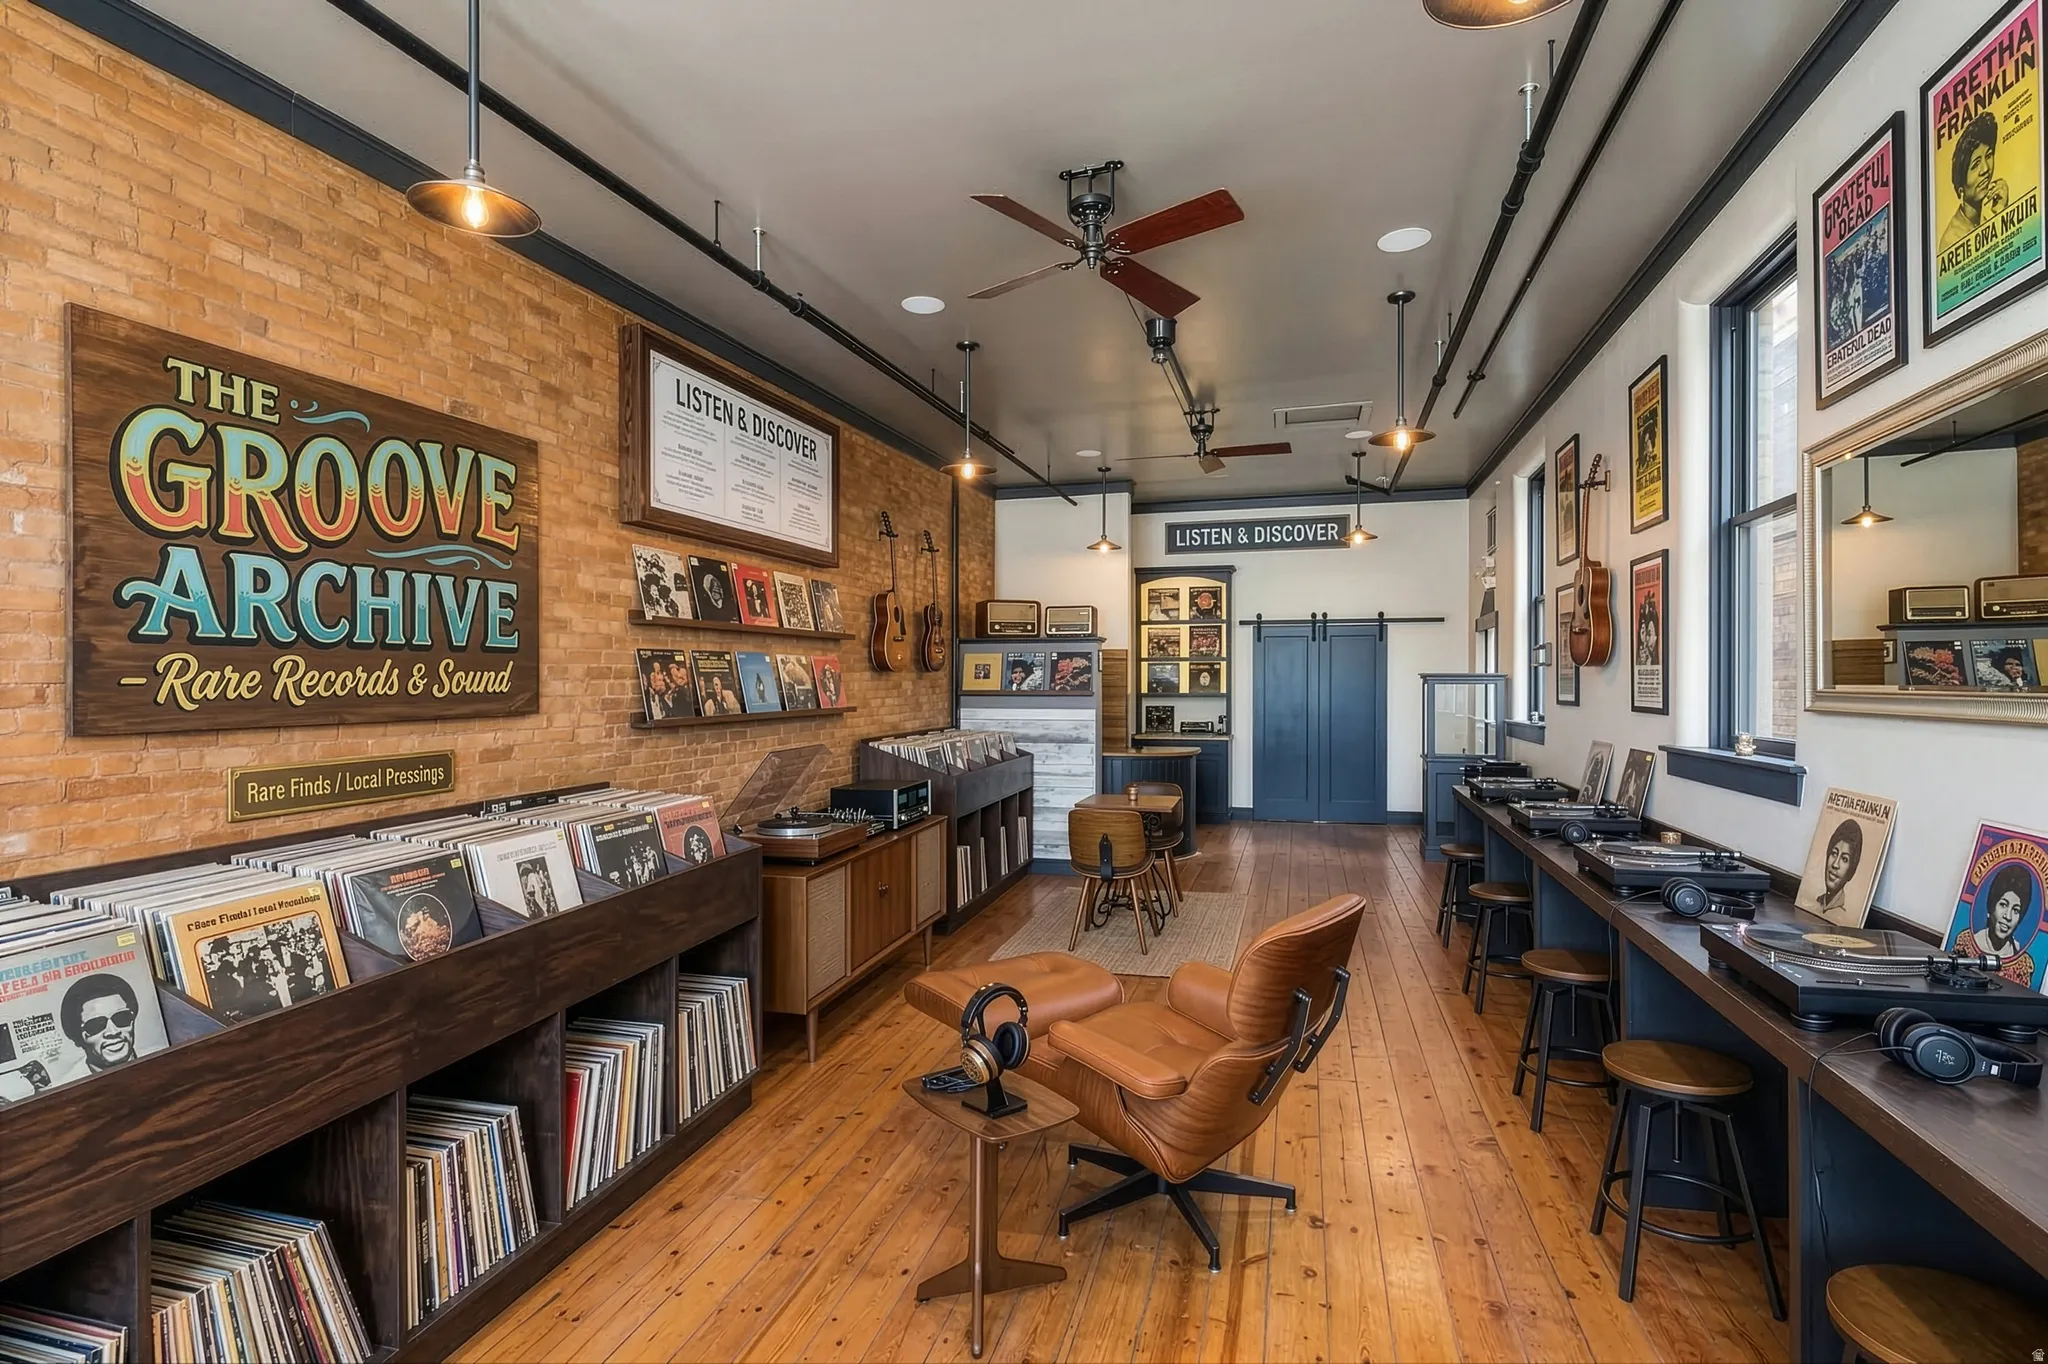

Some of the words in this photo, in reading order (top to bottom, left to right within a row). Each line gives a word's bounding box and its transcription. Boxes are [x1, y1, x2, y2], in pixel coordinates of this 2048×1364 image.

[1936, 43, 2036, 150] FRANKLIN
[1938, 17, 2034, 124] ARETHA
[1825, 153, 1889, 239] GRATEFUL
[1839, 194, 1873, 240] DEAD
[1867, 317, 1892, 345] DEAD
[165, 356, 281, 425] THE
[676, 378, 734, 426] LISTEN
[738, 407, 748, 433] &
[752, 413, 817, 462] DISCOVER
[114, 405, 519, 554] GROOVE
[1176, 527, 1232, 547] LISTEN
[1237, 527, 1249, 544] &
[1254, 523, 1339, 543] DISCOVER
[118, 545, 519, 649] ARCHIVE
[155, 652, 263, 711] Rare
[271, 653, 399, 707] Records
[411, 662, 427, 695] &
[432, 659, 513, 698] Sound
[247, 782, 286, 804] Rare
[290, 775, 331, 798] Finds
[335, 772, 342, 793] /
[346, 769, 382, 791] Local
[386, 764, 444, 787] Pressings
